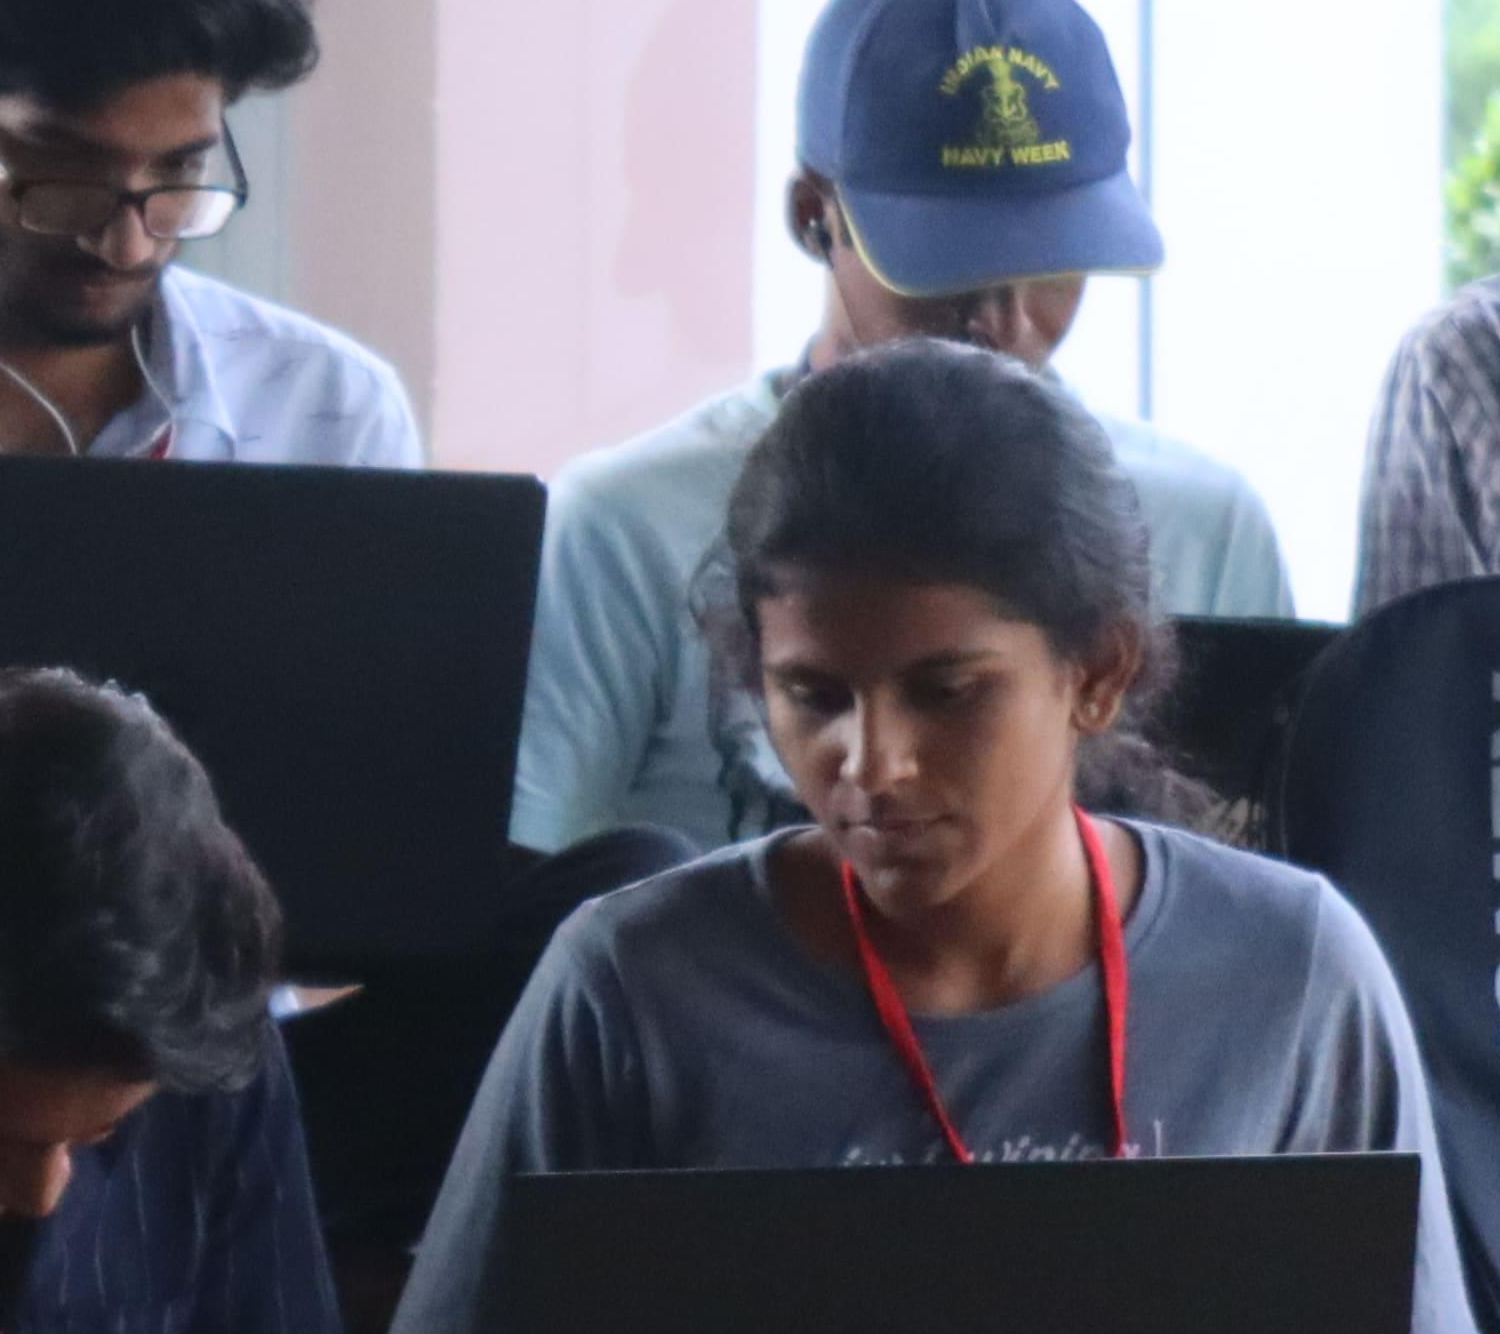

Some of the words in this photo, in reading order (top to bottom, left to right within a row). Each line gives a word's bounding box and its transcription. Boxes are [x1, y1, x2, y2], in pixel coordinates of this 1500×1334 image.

[1009, 47, 1060, 89] NAVY
[942, 146, 1003, 166] NAVY
[1012, 140, 1070, 164] WEEK
